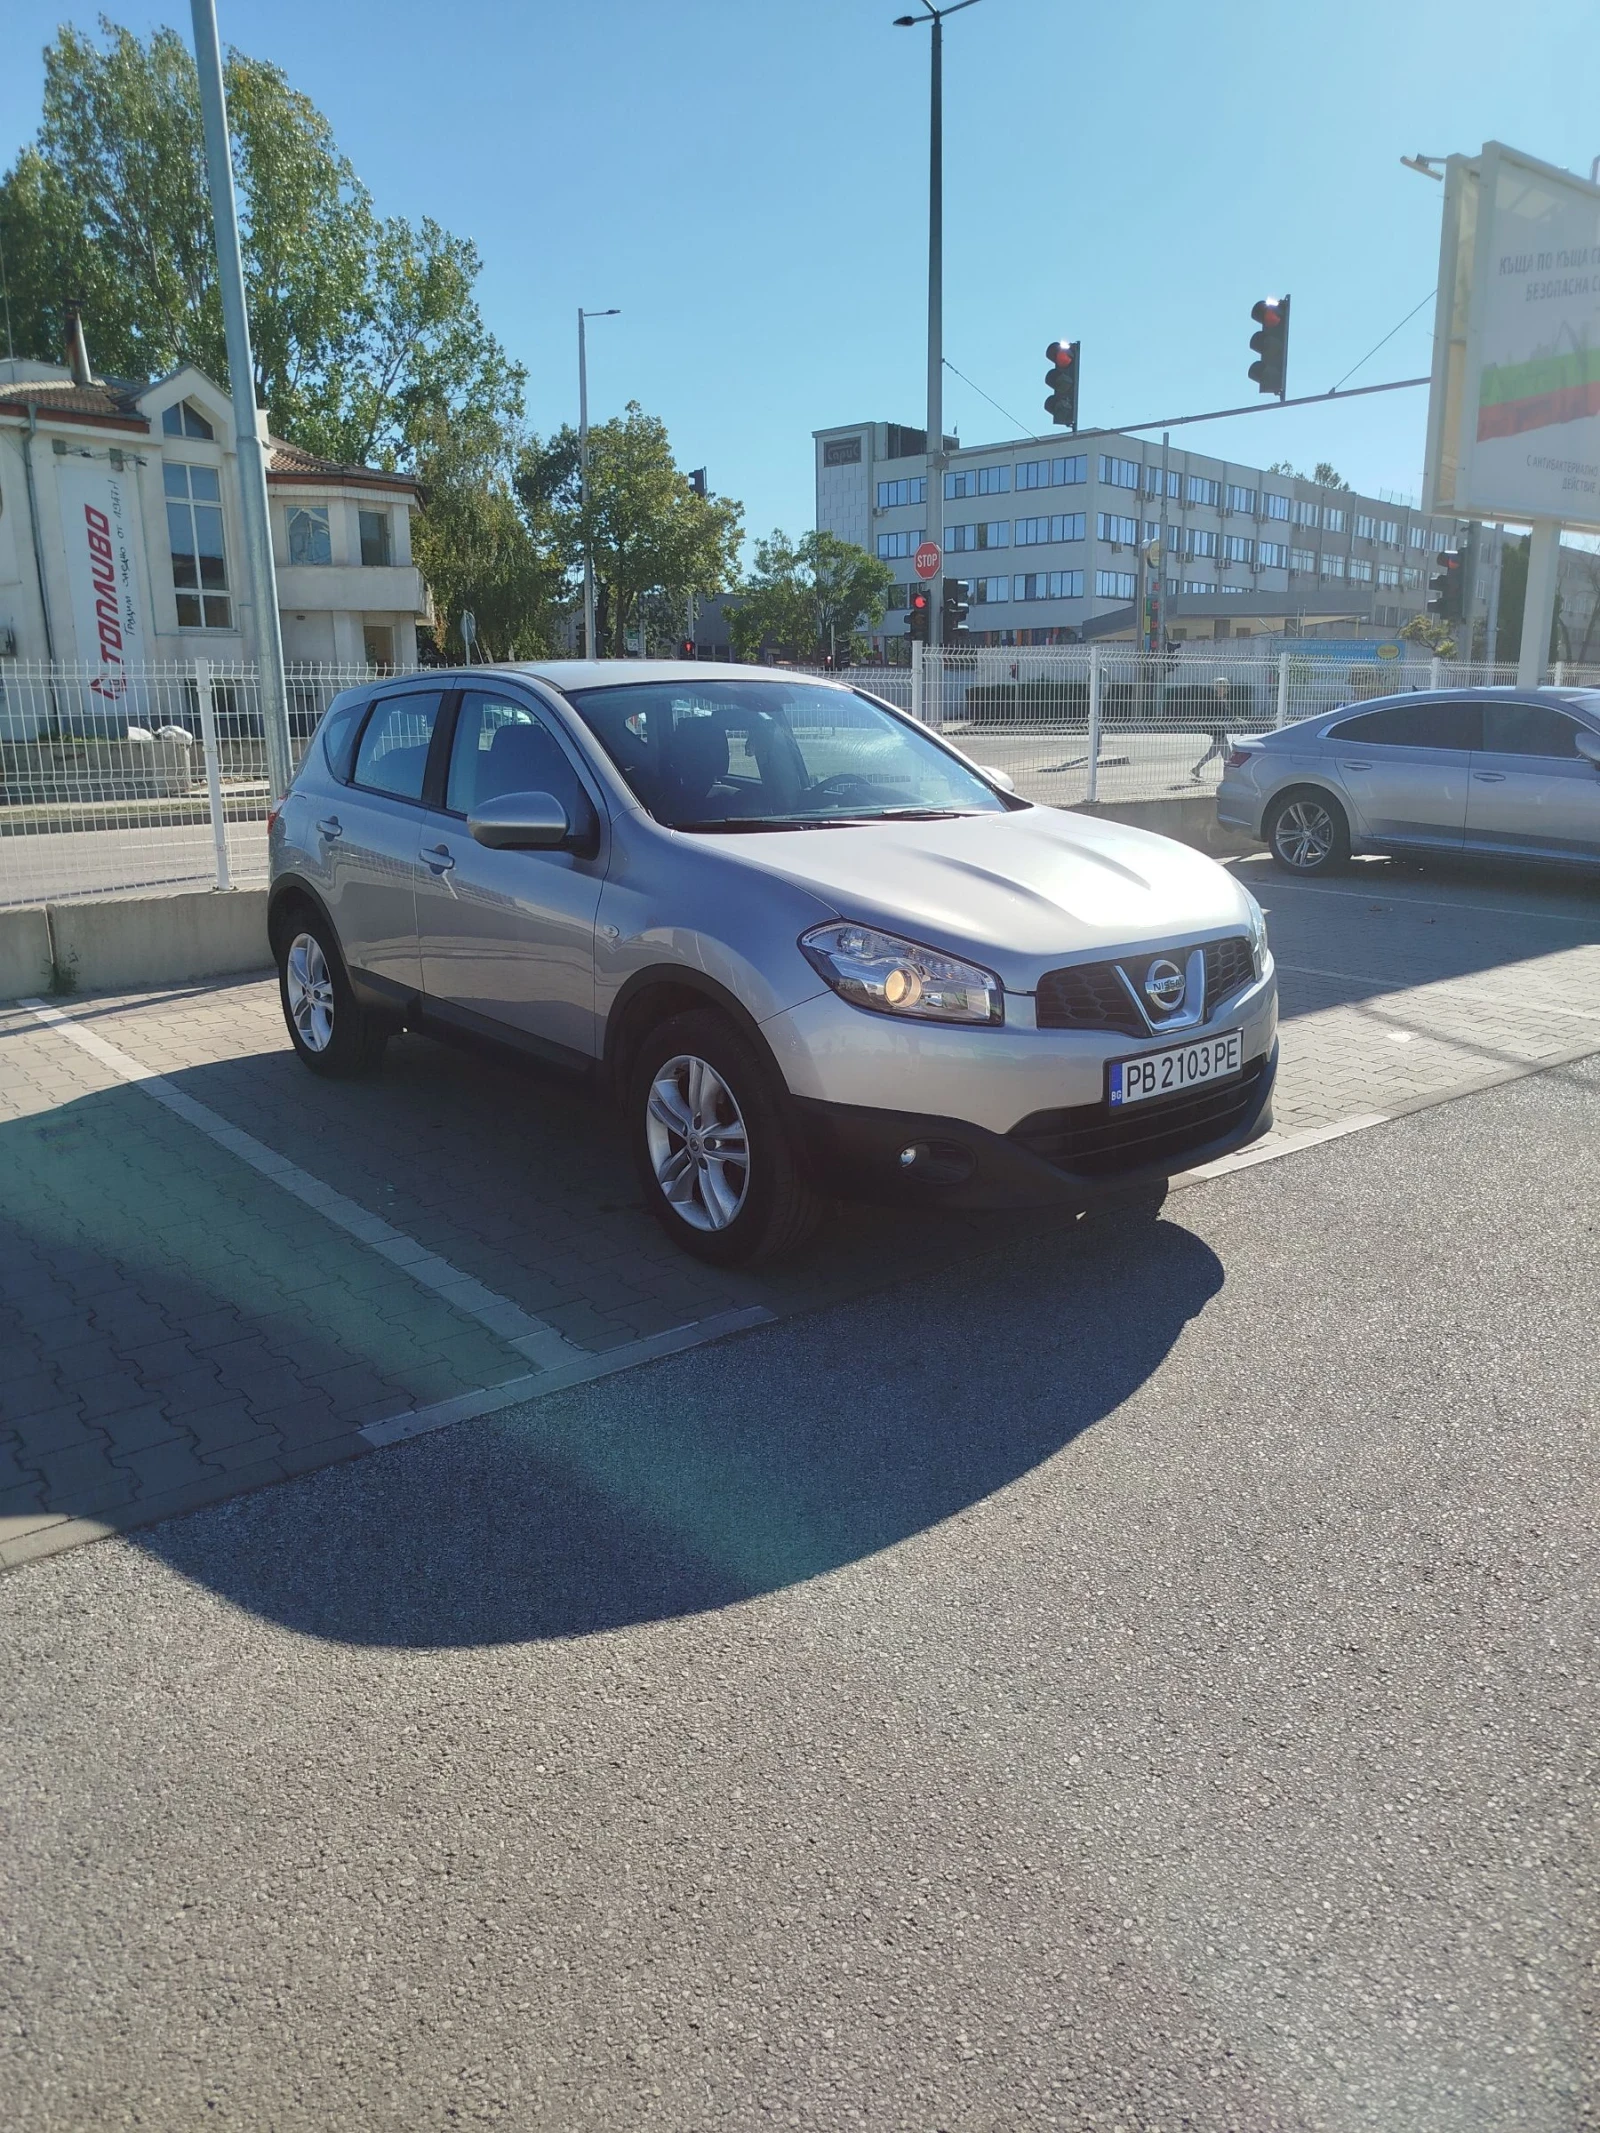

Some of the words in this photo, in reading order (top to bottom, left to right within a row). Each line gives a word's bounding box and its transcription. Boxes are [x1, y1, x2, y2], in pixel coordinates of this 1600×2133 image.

[1537, 251, 1553, 271] ПО
[1525, 277, 1589, 302] БЕЗОПАСНА
[917, 553, 938, 568] STOP
[84, 503, 124, 665] ТОПЛИВО
[1153, 977, 1184, 991] NISSAN
[1111, 1090, 1122, 1101] BG
